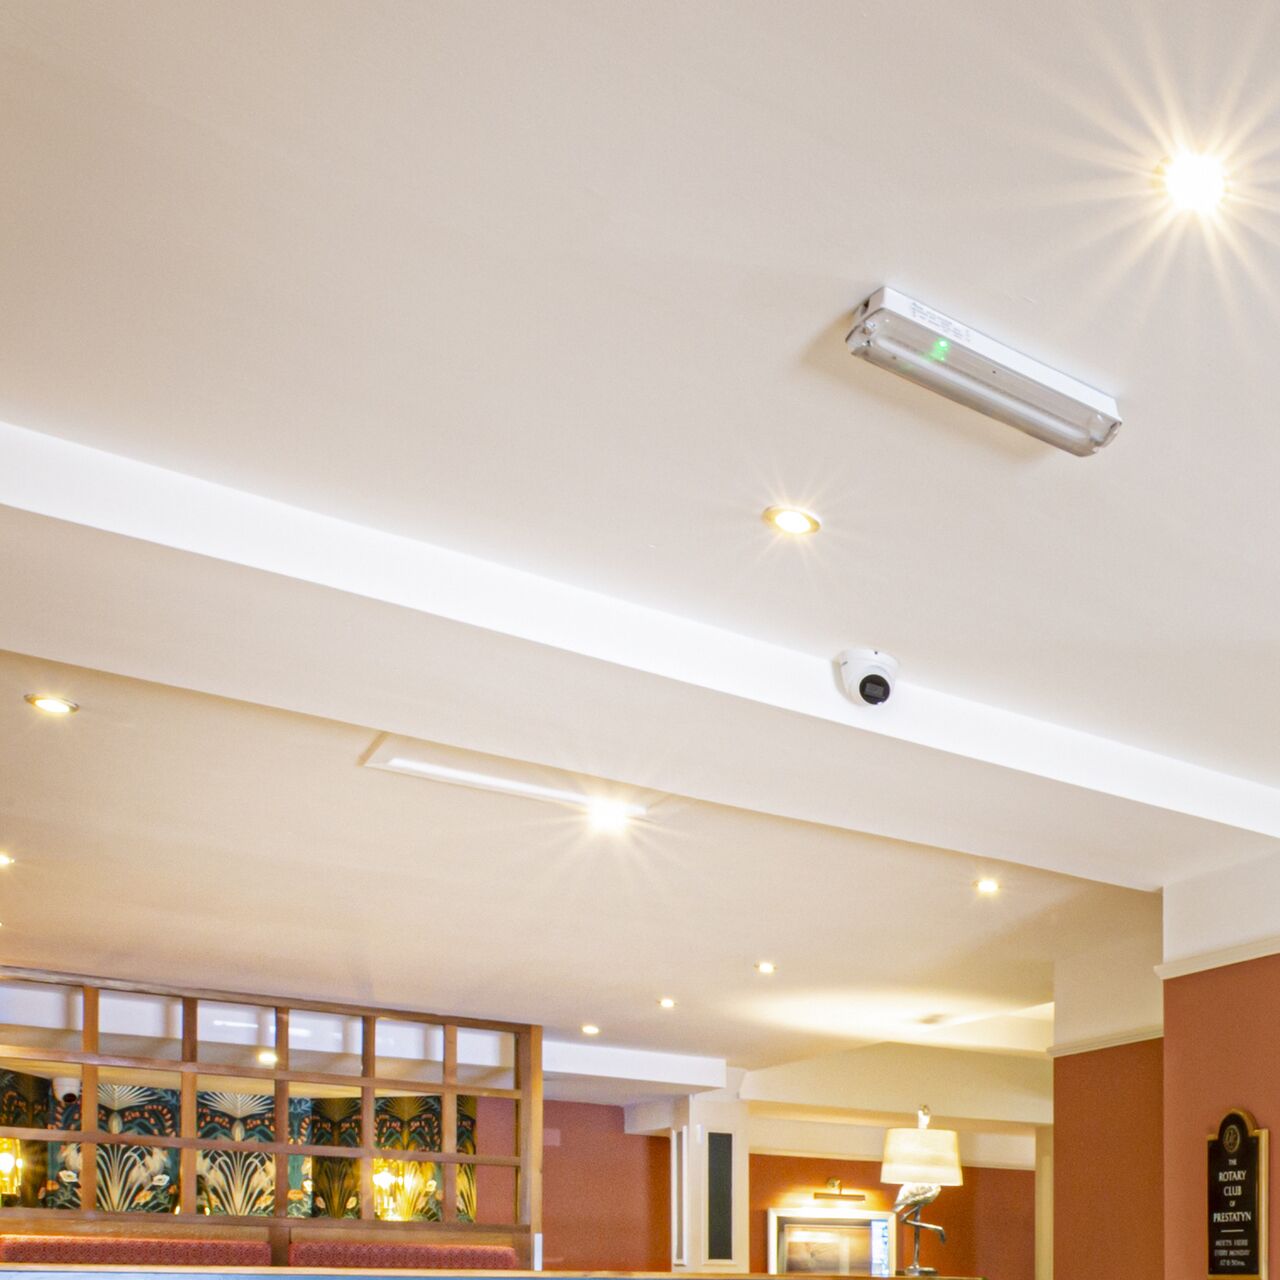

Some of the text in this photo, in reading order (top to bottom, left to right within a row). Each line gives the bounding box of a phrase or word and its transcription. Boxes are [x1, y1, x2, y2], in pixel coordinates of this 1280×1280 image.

[1218, 1170, 1247, 1182] ROTARY
[1223, 1185, 1242, 1196] CLUB
[1213, 1211, 1252, 1223] PRESTATYN
